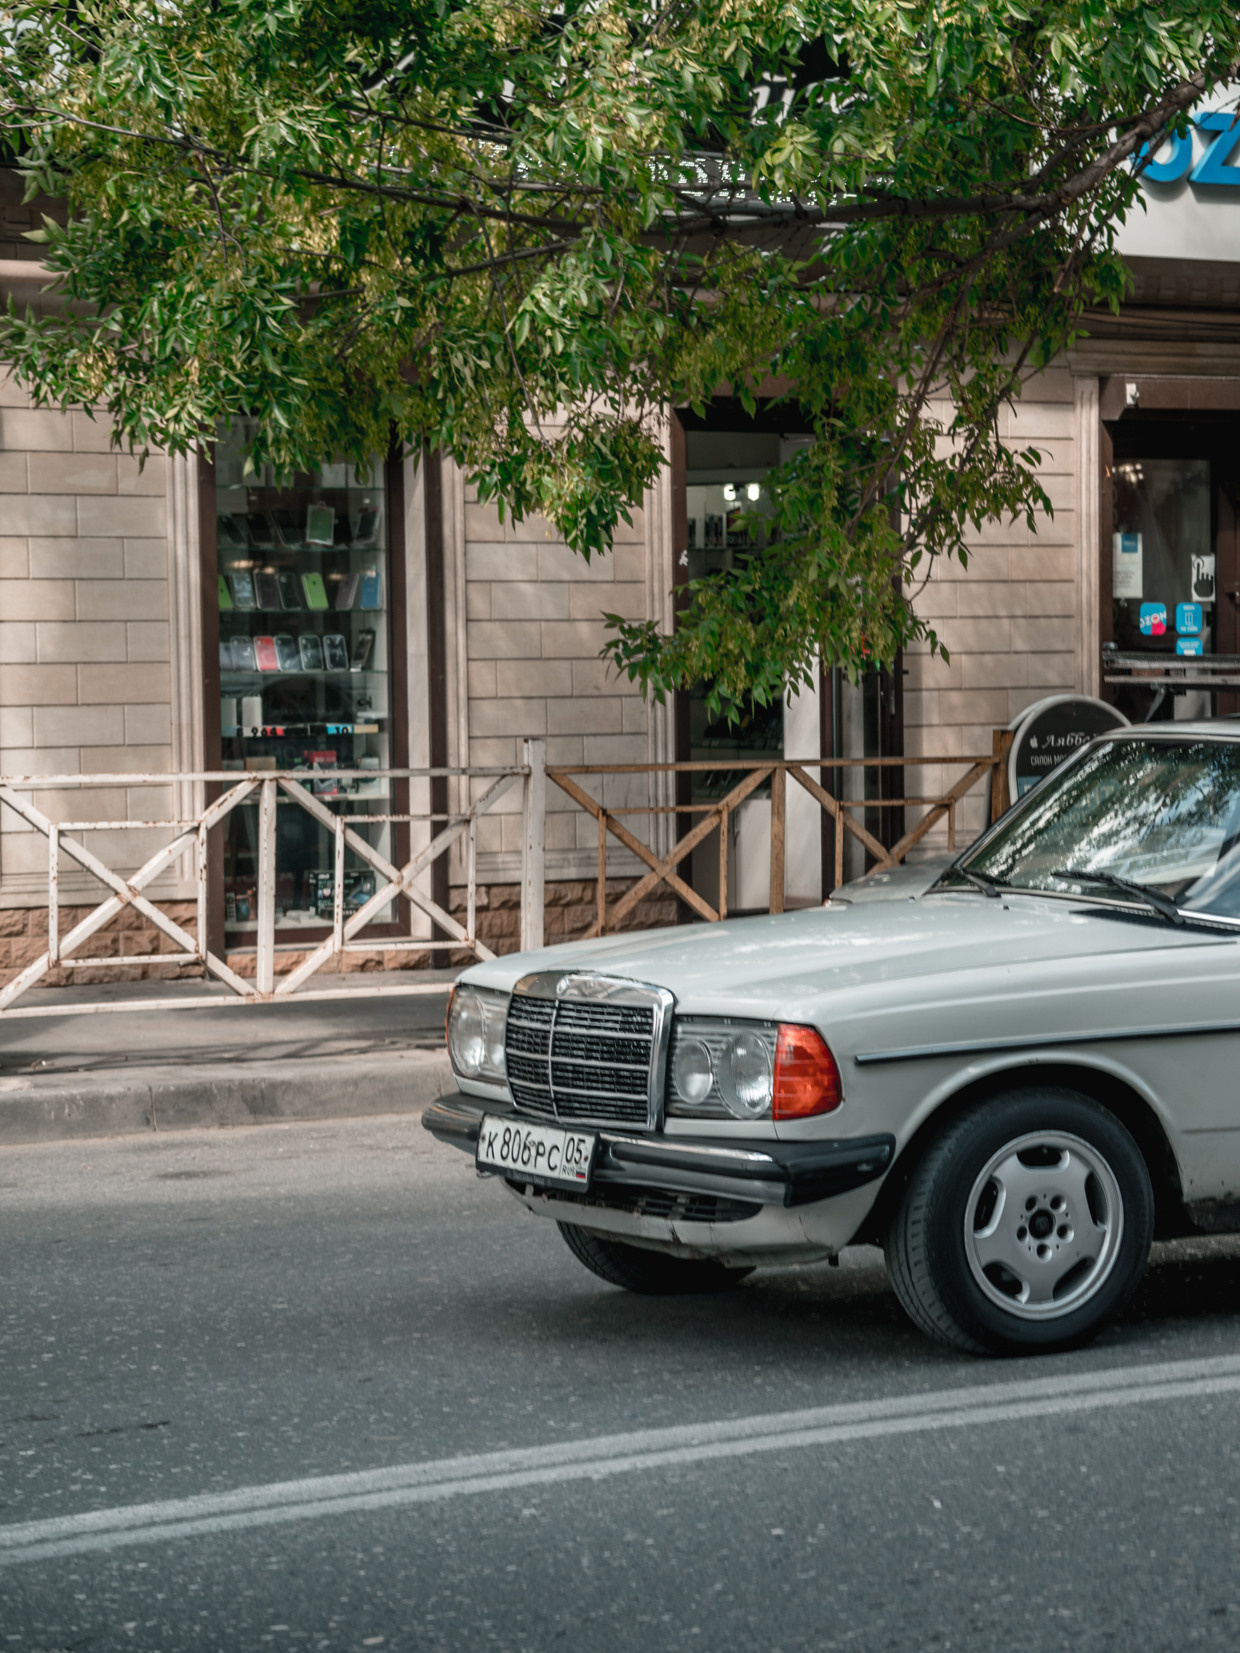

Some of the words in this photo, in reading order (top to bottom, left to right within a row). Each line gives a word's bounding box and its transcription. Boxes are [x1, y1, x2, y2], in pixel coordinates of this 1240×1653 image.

[1030, 755, 1053, 767] САЛОН
[485, 1127, 560, 1171] К806РС
[565, 1137, 586, 1165] 05
[562, 1166, 576, 1177] RUS
